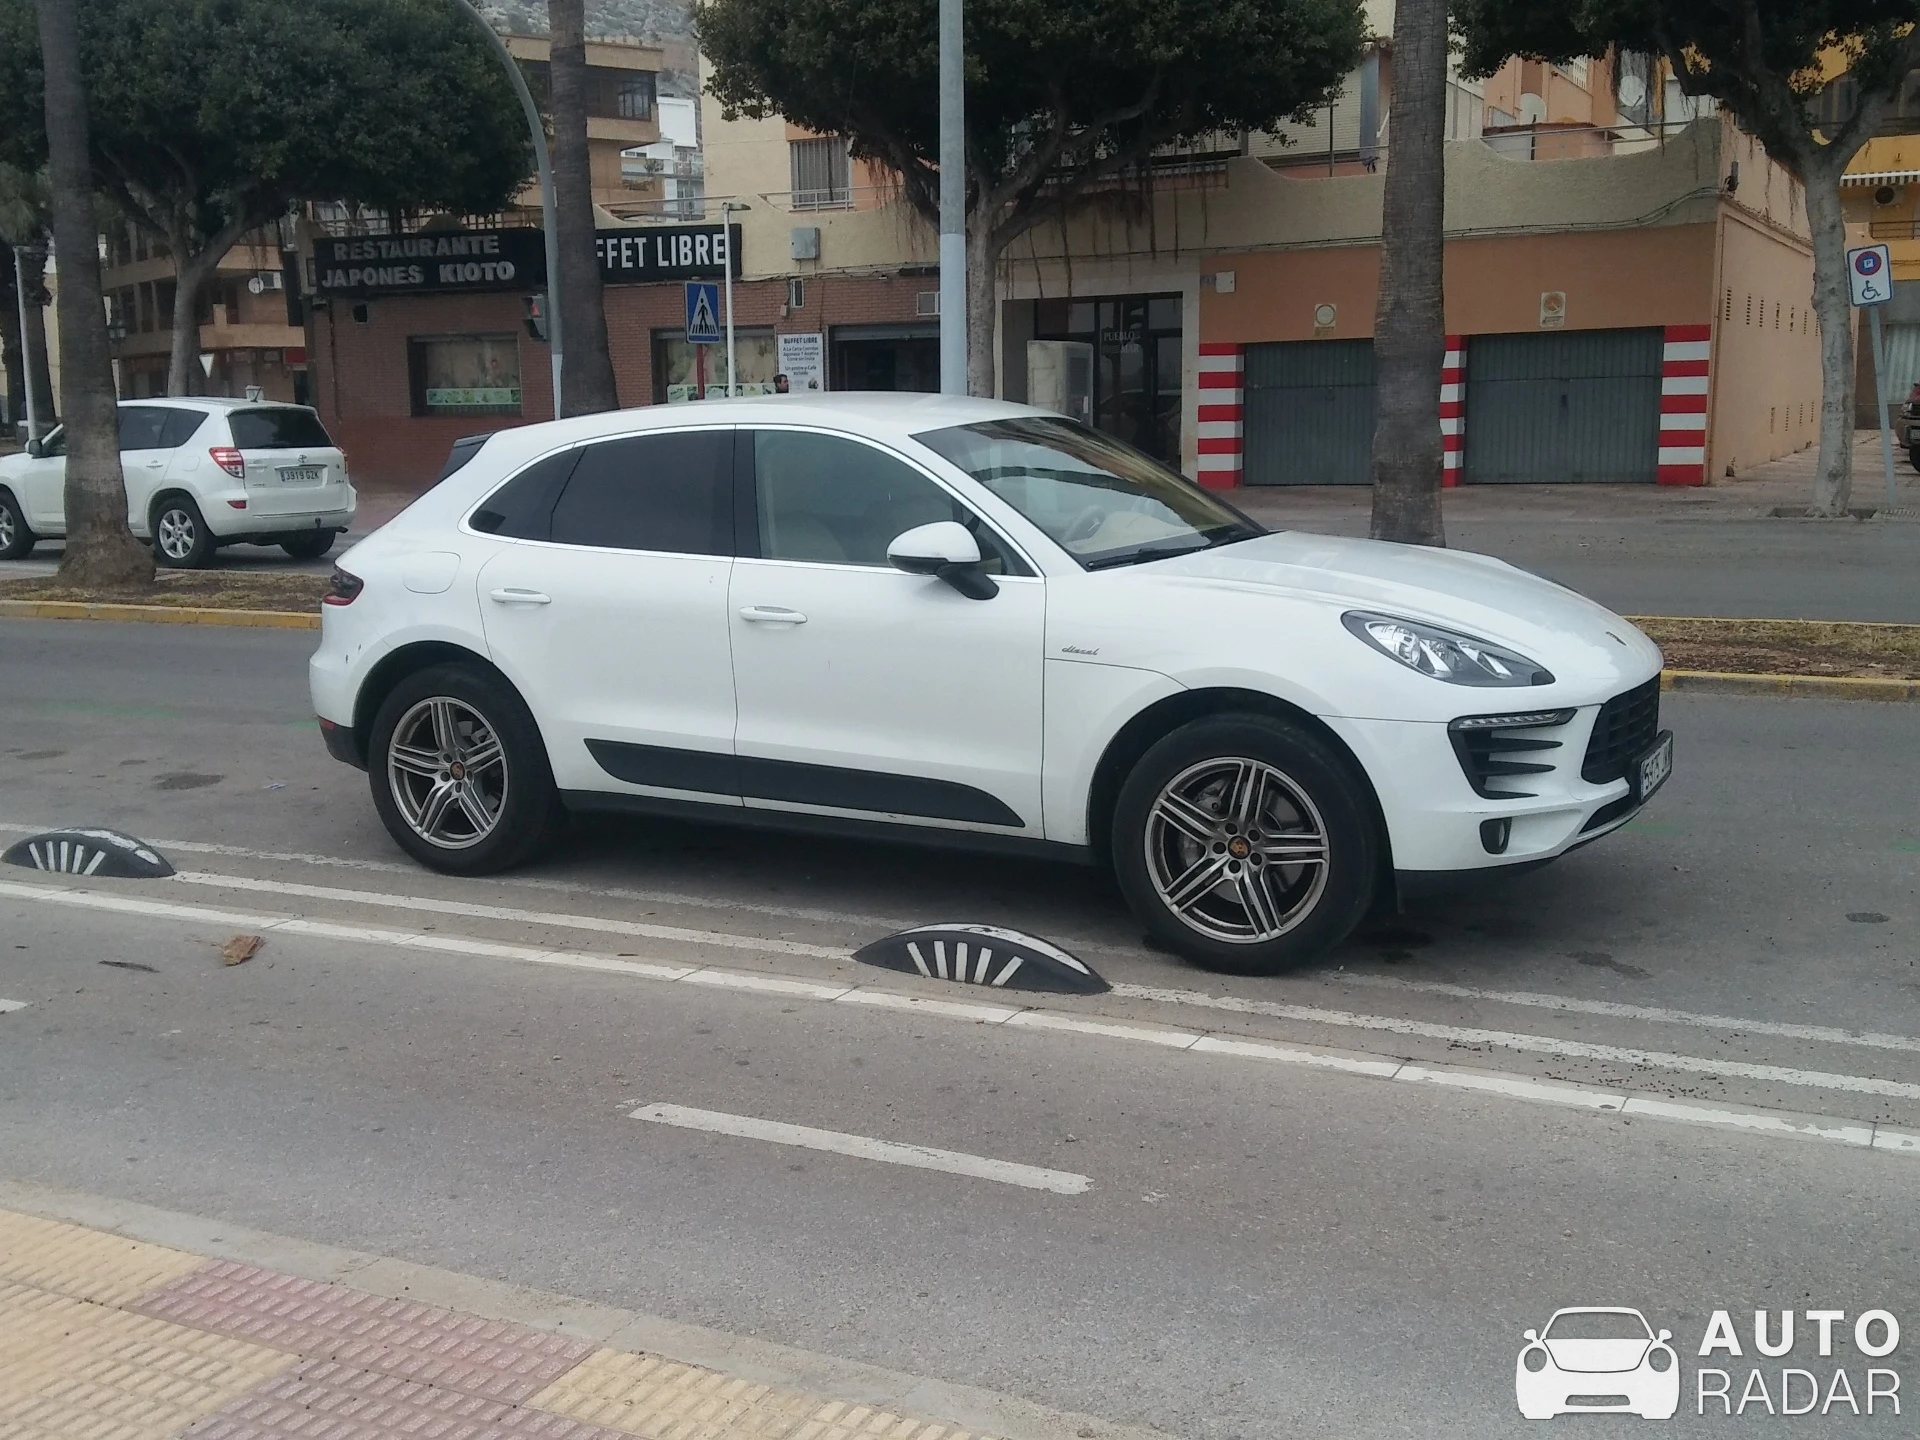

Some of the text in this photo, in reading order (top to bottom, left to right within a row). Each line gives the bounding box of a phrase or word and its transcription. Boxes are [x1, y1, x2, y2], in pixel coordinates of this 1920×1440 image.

[333, 235, 499, 261] RESTAURANTE
[595, 233, 726, 269] FFET LIBRE
[322, 260, 516, 288] JAPONES KIOTO
[803, 336, 818, 344] LIBRE
[1104, 331, 1134, 341] PUEBLO
[286, 470, 319, 480] 3919 GZK
